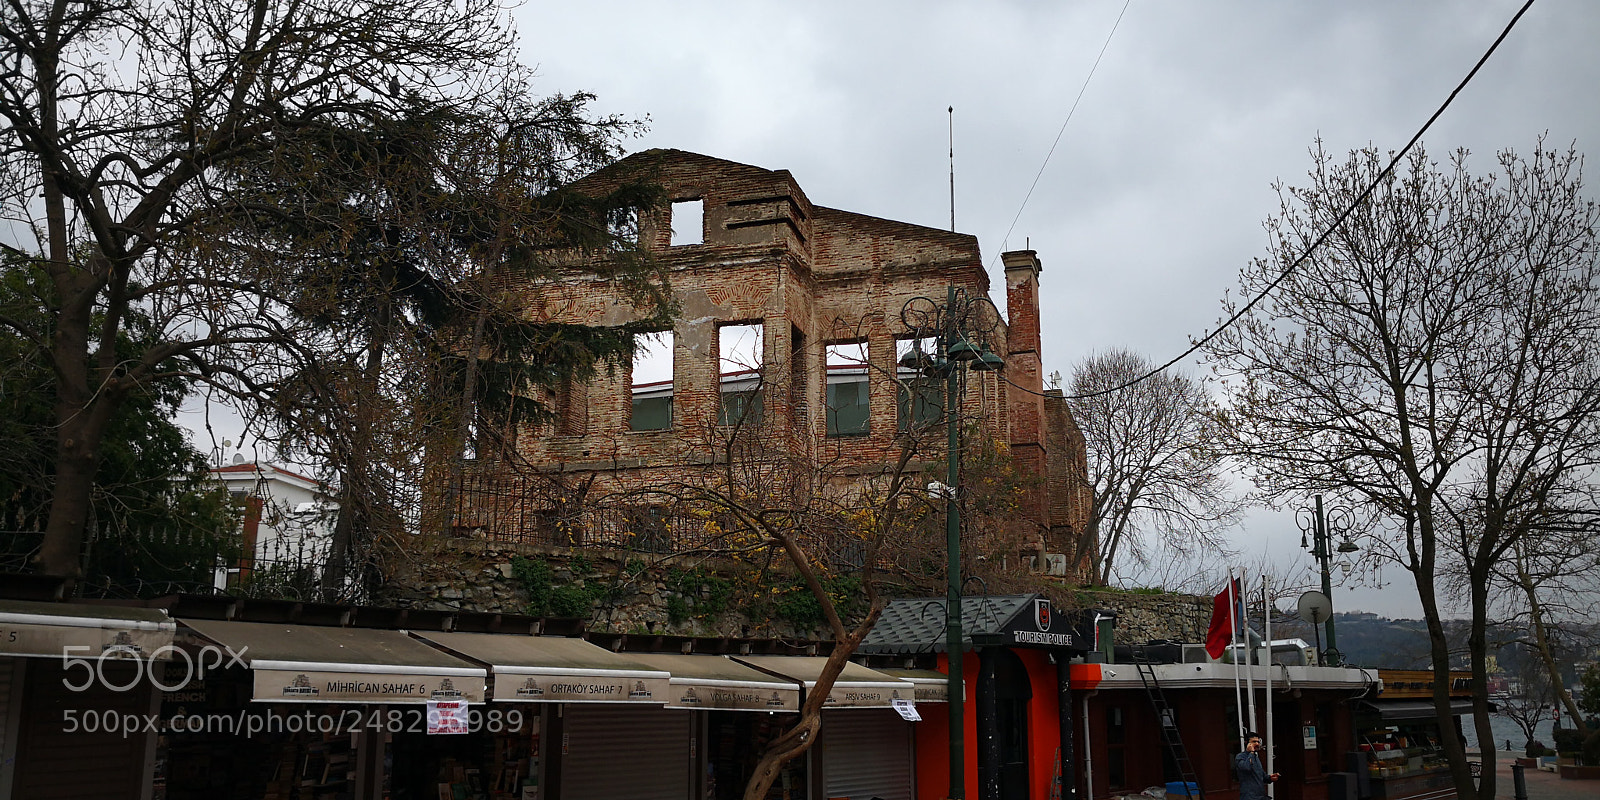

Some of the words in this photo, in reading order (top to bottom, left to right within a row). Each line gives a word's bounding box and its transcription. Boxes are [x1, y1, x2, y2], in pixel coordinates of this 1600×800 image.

[8, 631, 17, 642] 5
[1047, 634, 1072, 645] POLICE
[326, 680, 379, 694] MİHRİCAN
[382, 682, 415, 694] SAHAF
[419, 684, 426, 694] 6
[551, 683, 588, 693] ORTAKÖY
[589, 684, 615, 694] SAHAF
[618, 685, 623, 694] 7
